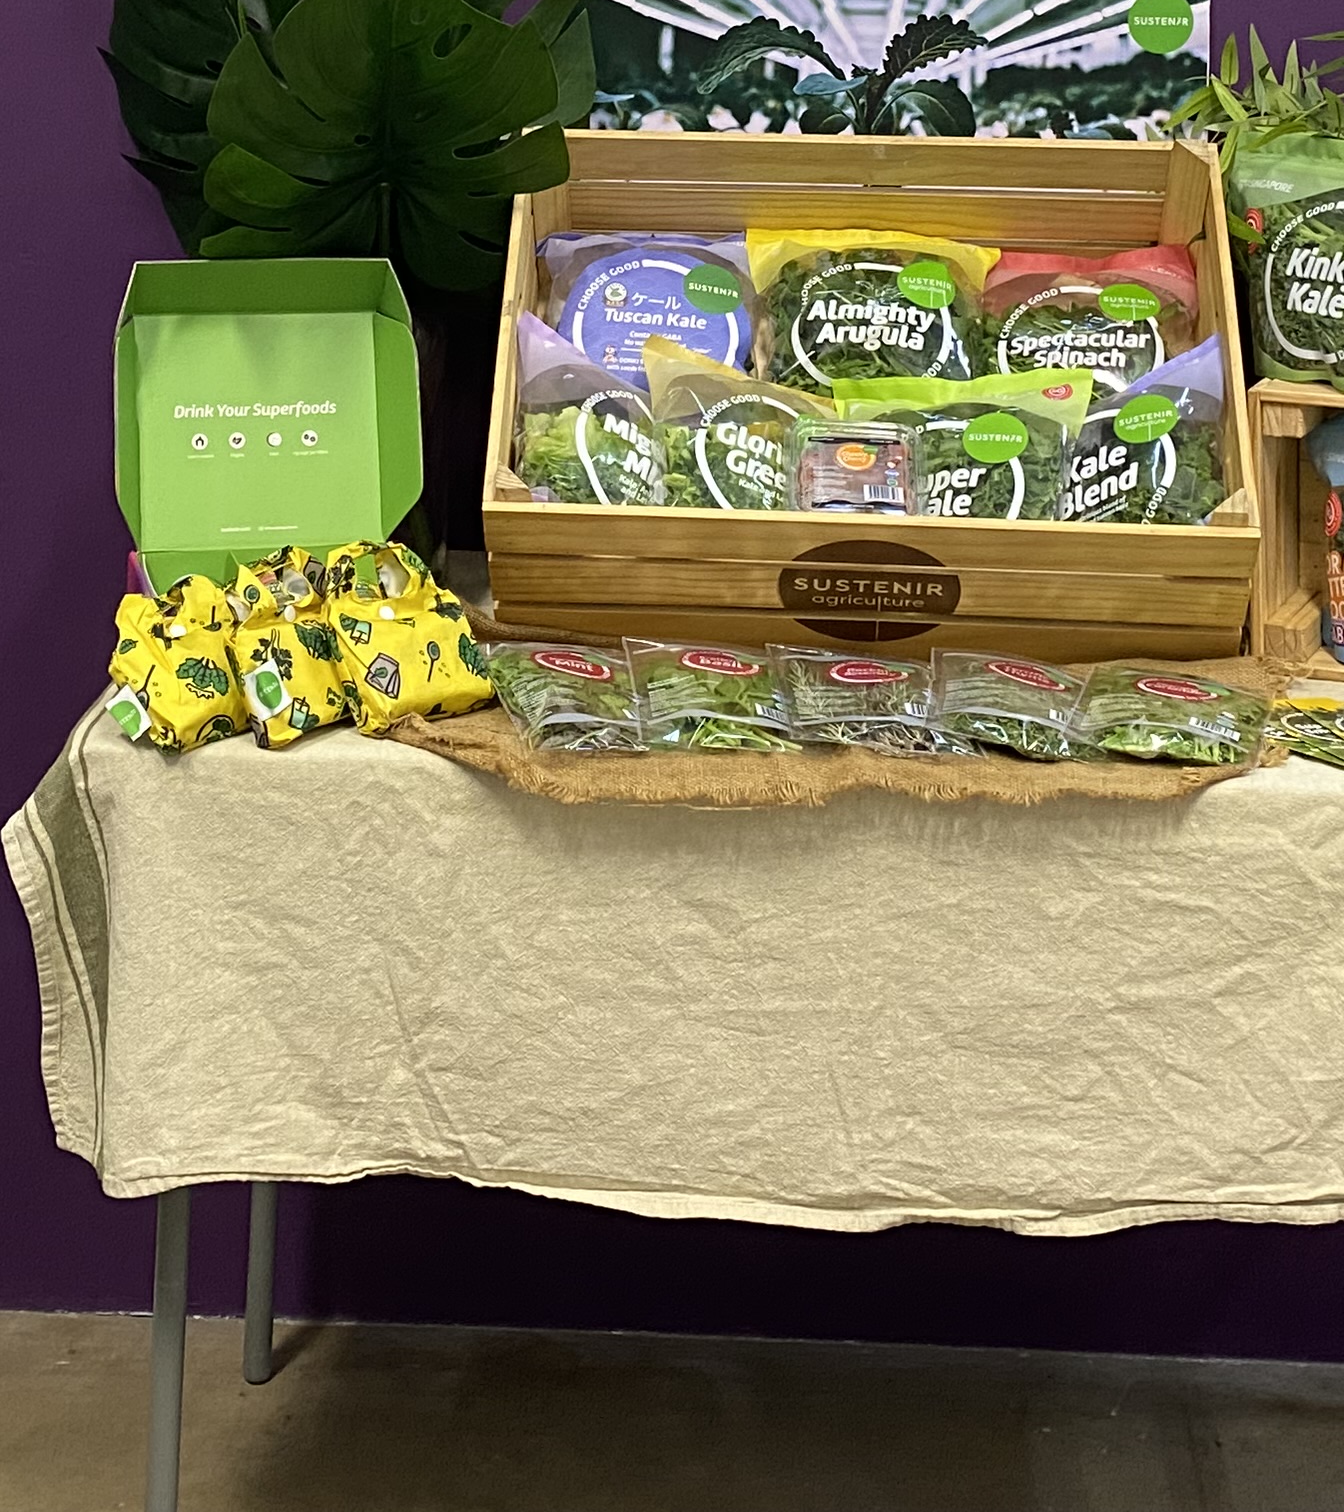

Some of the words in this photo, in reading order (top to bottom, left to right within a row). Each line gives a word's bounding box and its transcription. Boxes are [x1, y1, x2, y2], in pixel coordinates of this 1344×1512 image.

[1133, 16, 1190, 27] SUSTENIR
[631, 292, 682, 311] ケール
[687, 282, 740, 300] SUSTENIR
[604, 308, 664, 326] Tuscan
[666, 313, 708, 331] Kale
[806, 299, 936, 333] Almighty
[815, 322, 925, 352] Arugula
[1010, 330, 1152, 357] Spectacular
[1032, 348, 1128, 370] Spinach
[173, 402, 215, 421] Drink
[216, 402, 253, 419] Your
[252, 400, 338, 420] Superfoods
[1068, 445, 1128, 484] Kale
[1059, 462, 1140, 521] Blend
[793, 576, 946, 599] SUSTENIR
[811, 592, 926, 611] agriculture
[554, 658, 595, 673] Mint
[699, 657, 744, 671] Basil
